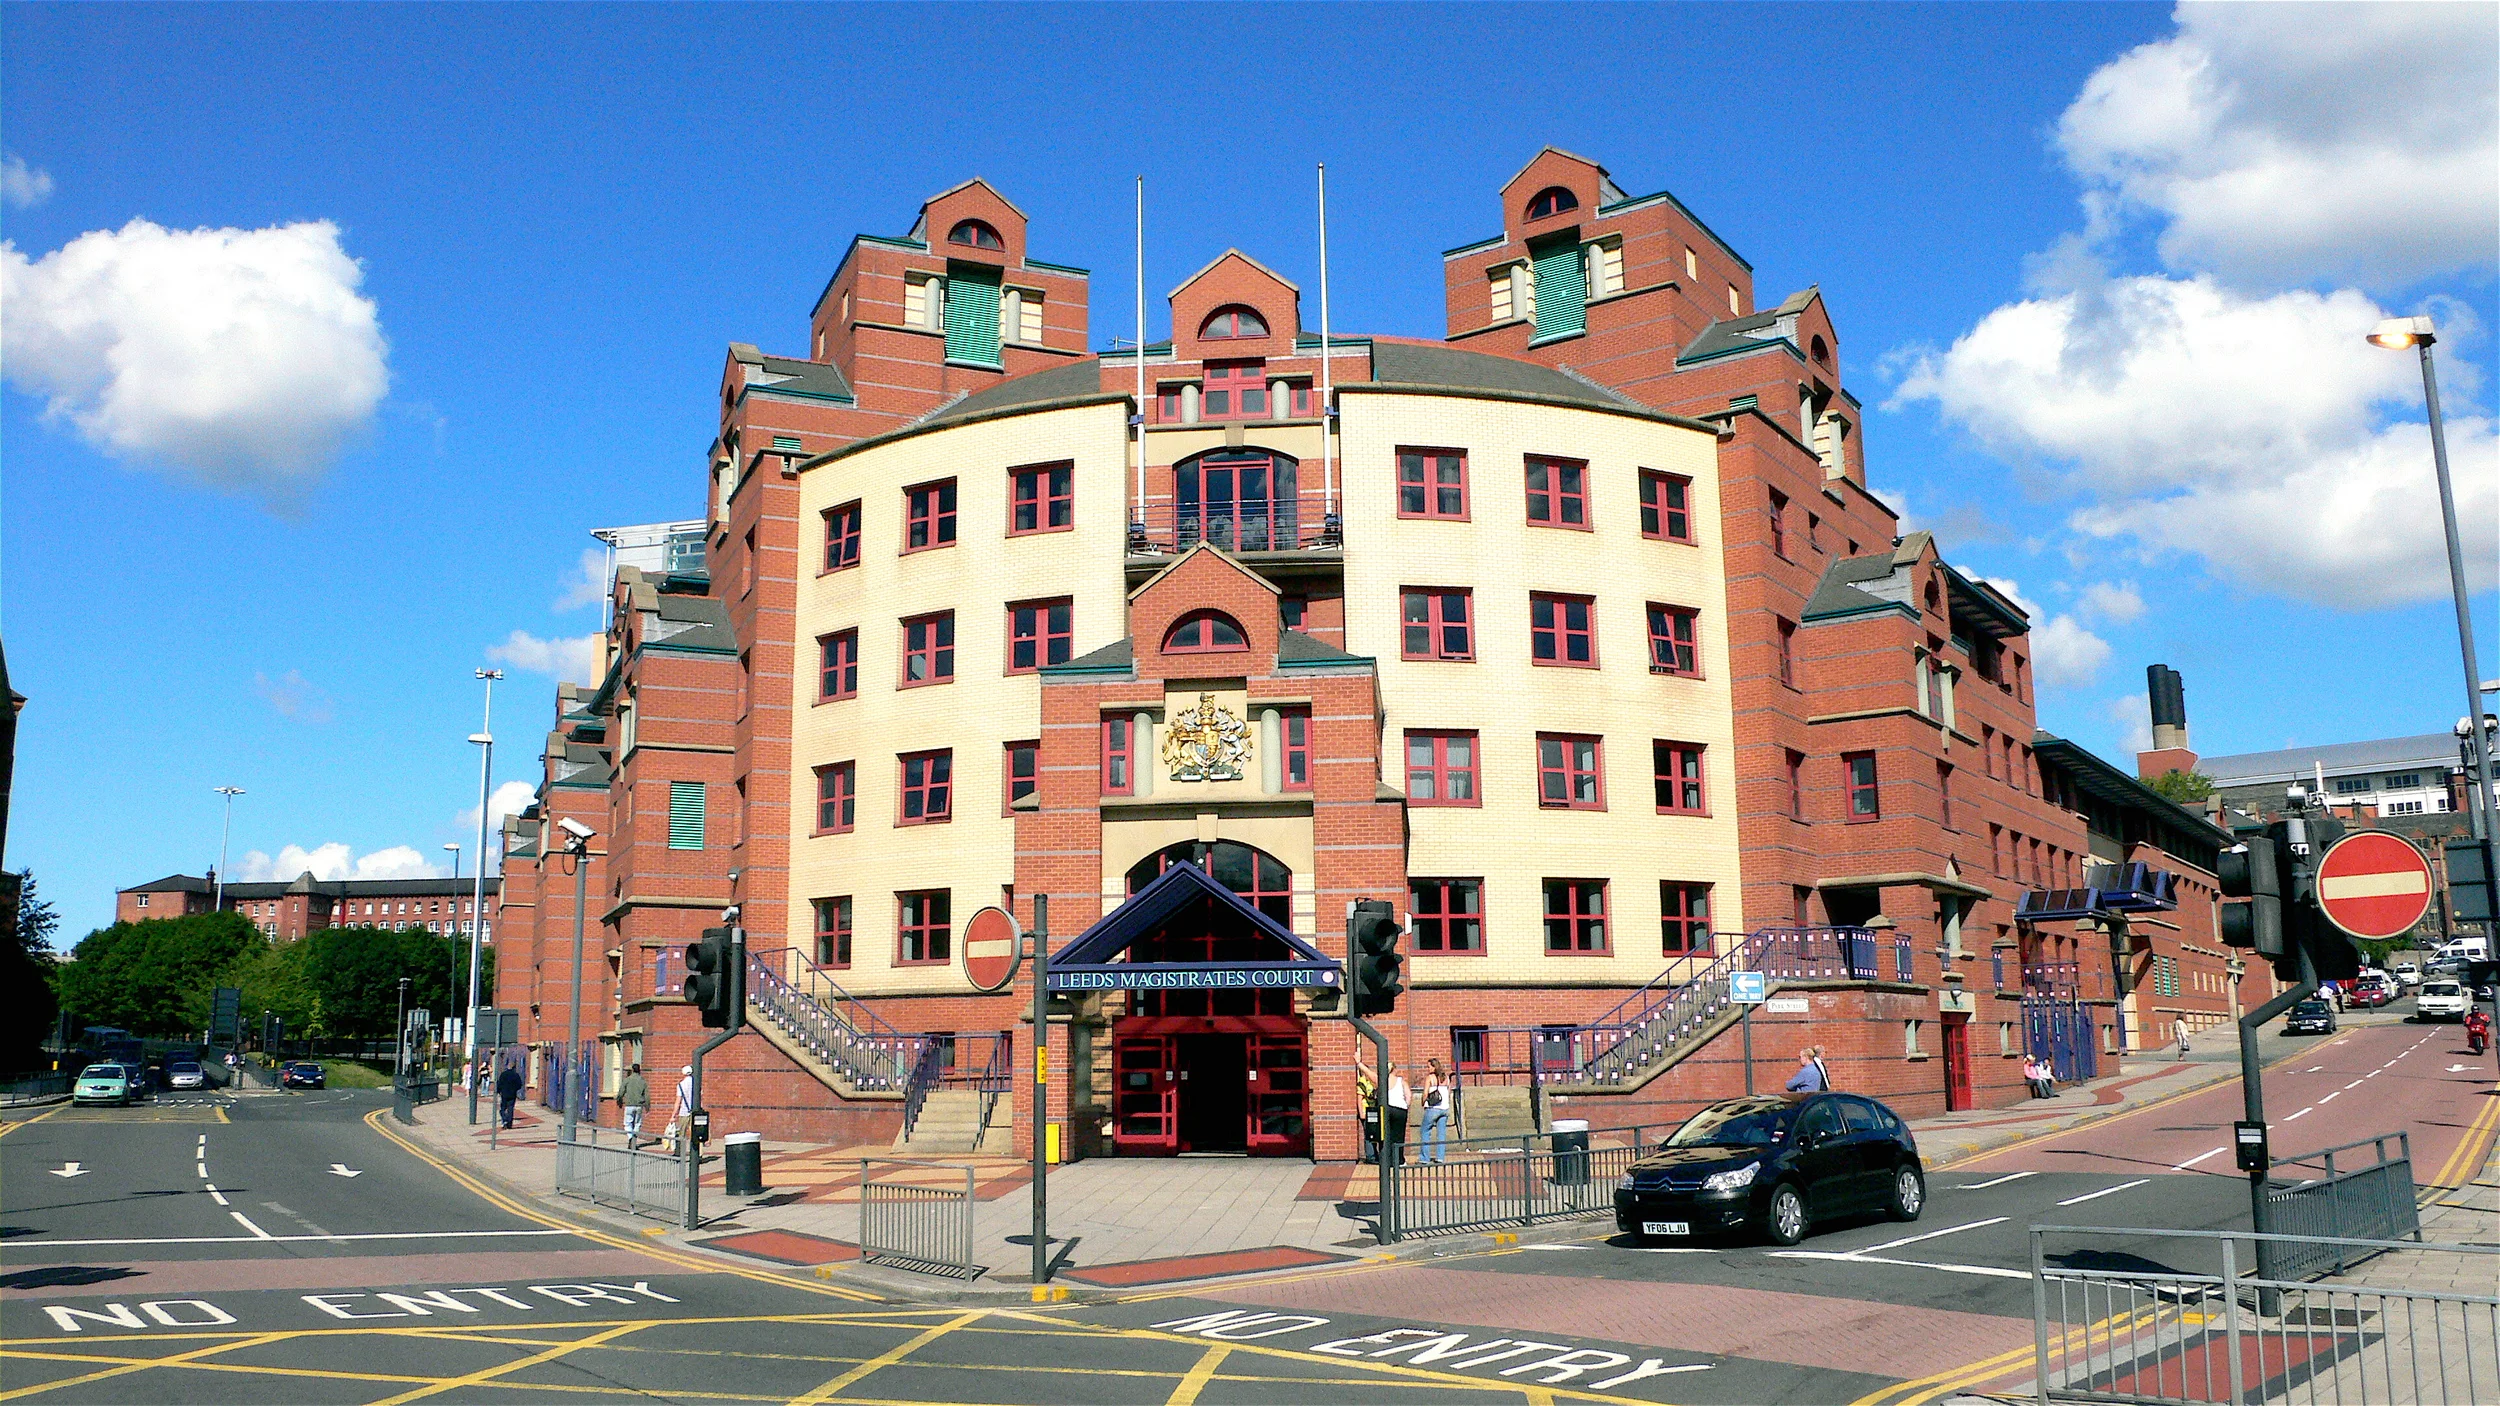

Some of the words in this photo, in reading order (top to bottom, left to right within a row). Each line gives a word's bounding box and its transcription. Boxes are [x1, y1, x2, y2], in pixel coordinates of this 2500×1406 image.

[1058, 972, 1115, 988] LEEDS
[1120, 970, 1246, 988] MAGISTRATES
[1251, 969, 1314, 986] COURT
[1733, 992, 1747, 1000] ONE
[1749, 992, 1762, 1000] WAY
[1646, 1223, 1668, 1233] YF06
[1668, 1223, 1686, 1233] LJU
[42, 1300, 237, 1331] NO
[301, 1282, 681, 1319] ENTRY
[1150, 1309, 1330, 1340] NO
[1309, 1328, 1715, 1389] ENTRY
